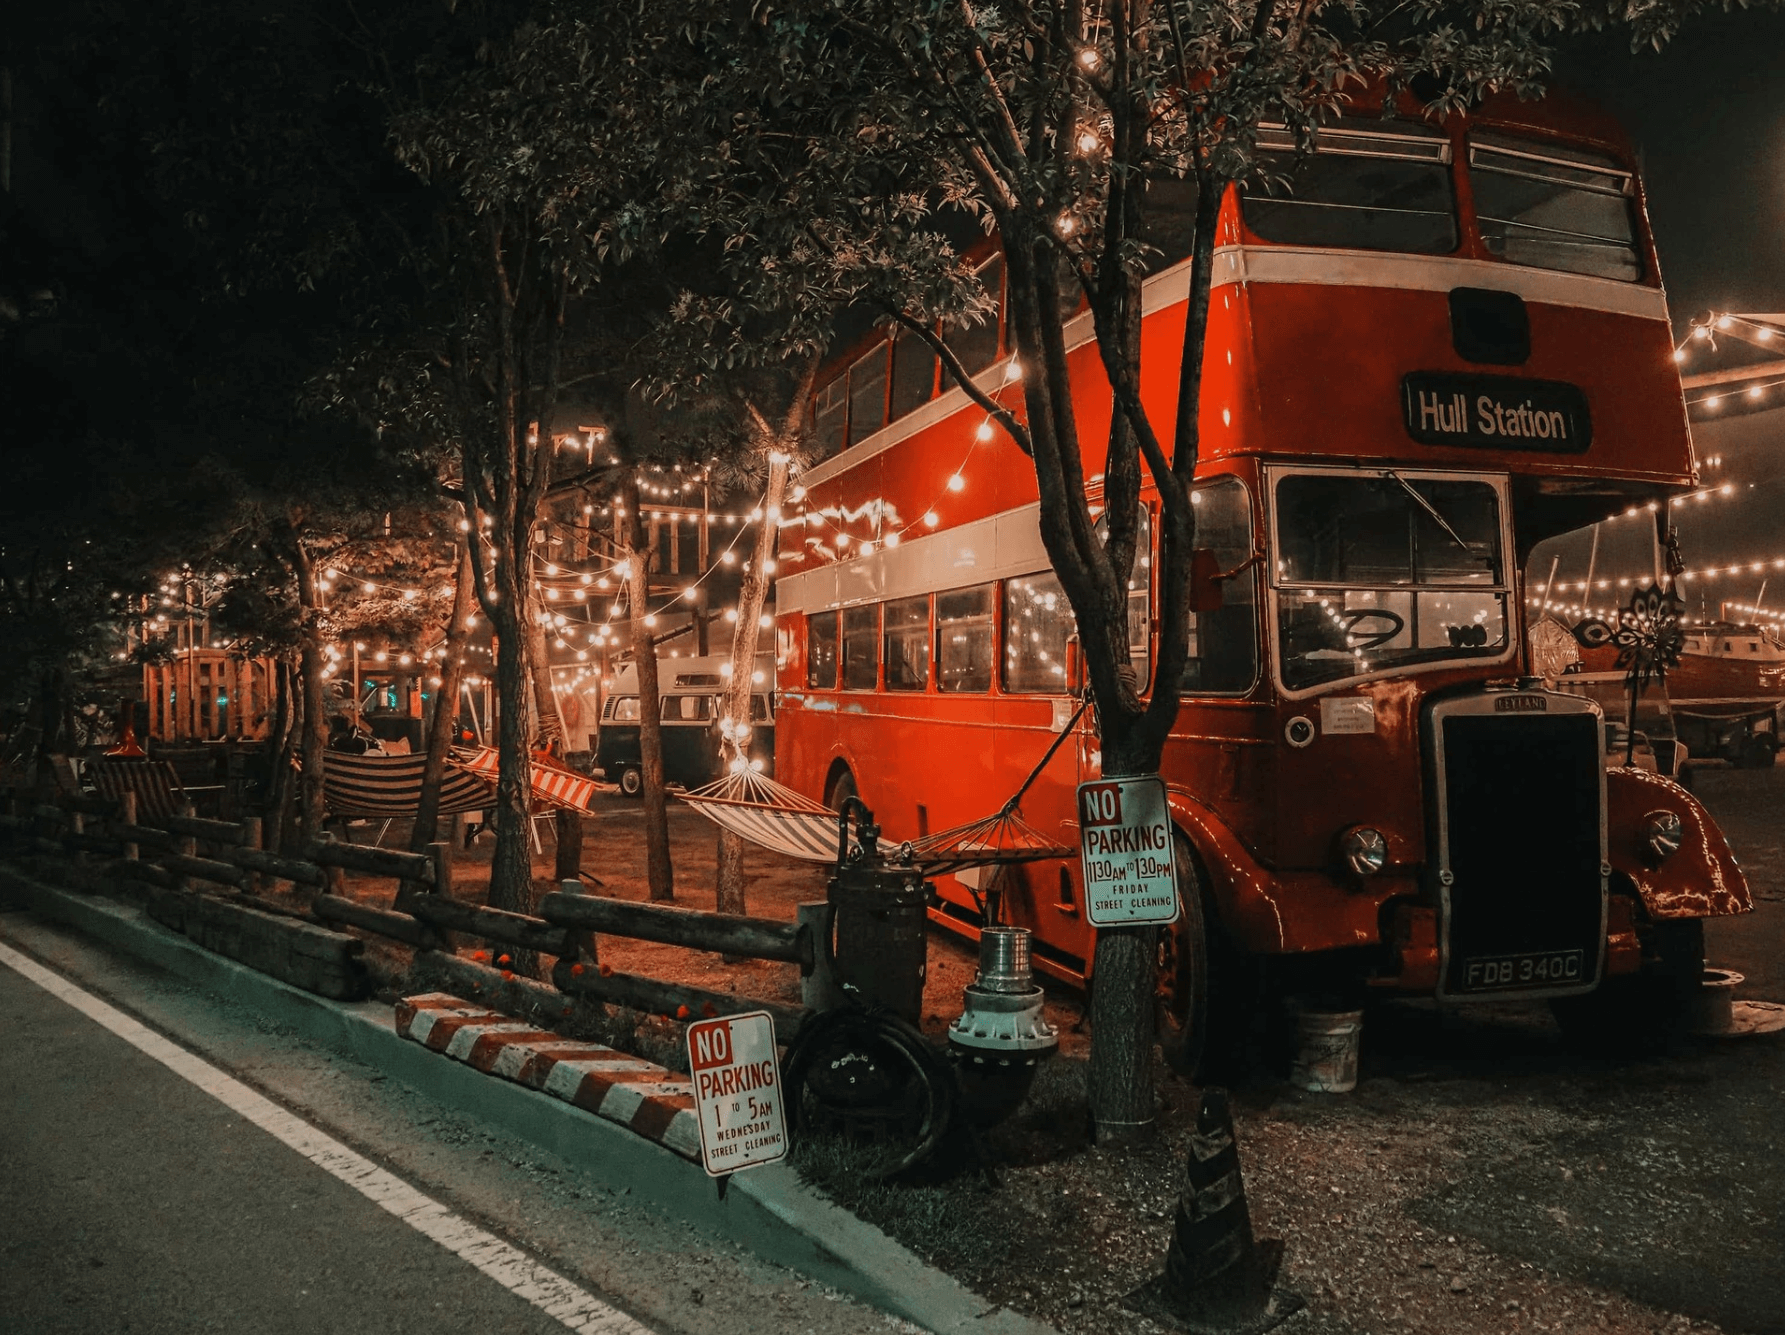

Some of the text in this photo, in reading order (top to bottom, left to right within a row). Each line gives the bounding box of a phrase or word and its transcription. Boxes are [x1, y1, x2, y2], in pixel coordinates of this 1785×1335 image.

[1419, 390, 1567, 439] Hull Station
[1498, 697, 1546, 710] LEYLAND
[1085, 789, 1116, 822] NO
[1087, 825, 1166, 855] PARKING
[1126, 862, 1135, 872] TO
[1113, 883, 1149, 895] FRIDAY
[1095, 896, 1171, 910] STREET CLEANING
[1519, 955, 1578, 981] 340C
[696, 1027, 727, 1064] NO
[700, 1060, 774, 1100] PARKING
[714, 1104, 721, 1128] 1
[732, 1102, 740, 1113] TO
[717, 1120, 771, 1142] WEDNESDAY
[711, 1133, 781, 1159] STREET CLEANING
